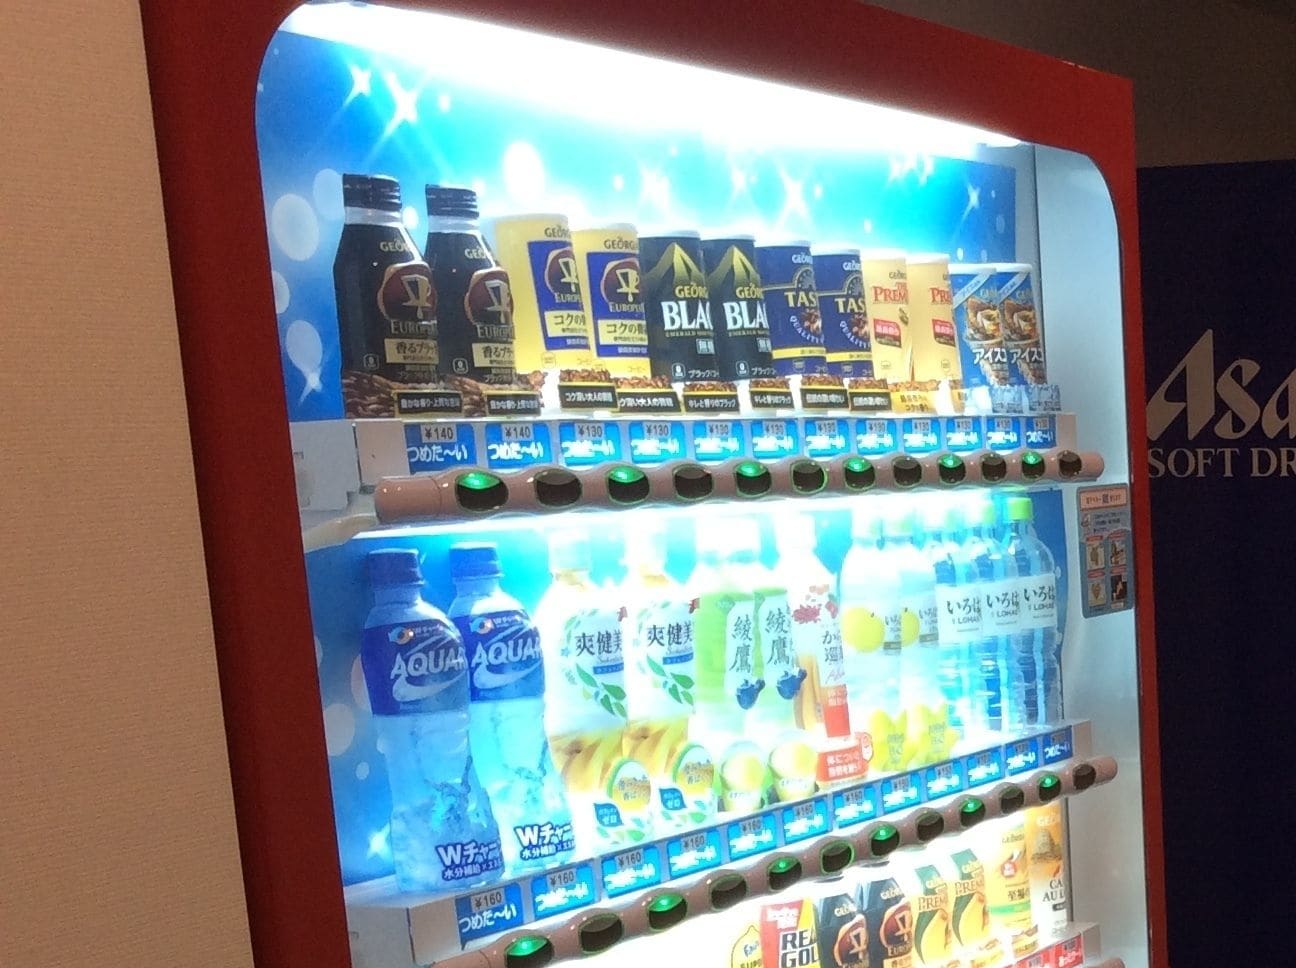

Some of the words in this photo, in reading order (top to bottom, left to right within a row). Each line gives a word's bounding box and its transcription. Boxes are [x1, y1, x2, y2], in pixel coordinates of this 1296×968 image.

[423, 426, 454, 441] ¥140
[504, 425, 532, 439] ¥140
[577, 424, 604, 438] ¥130
[646, 423, 669, 437] ¥130
[1148, 447, 1240, 478] SOFT
[729, 615, 753, 674] 綾鷹
[683, 835, 706, 849] ¥160
[617, 851, 643, 867] ¥160
[549, 870, 575, 888] ¥160
[474, 891, 503, 910] ¥160
